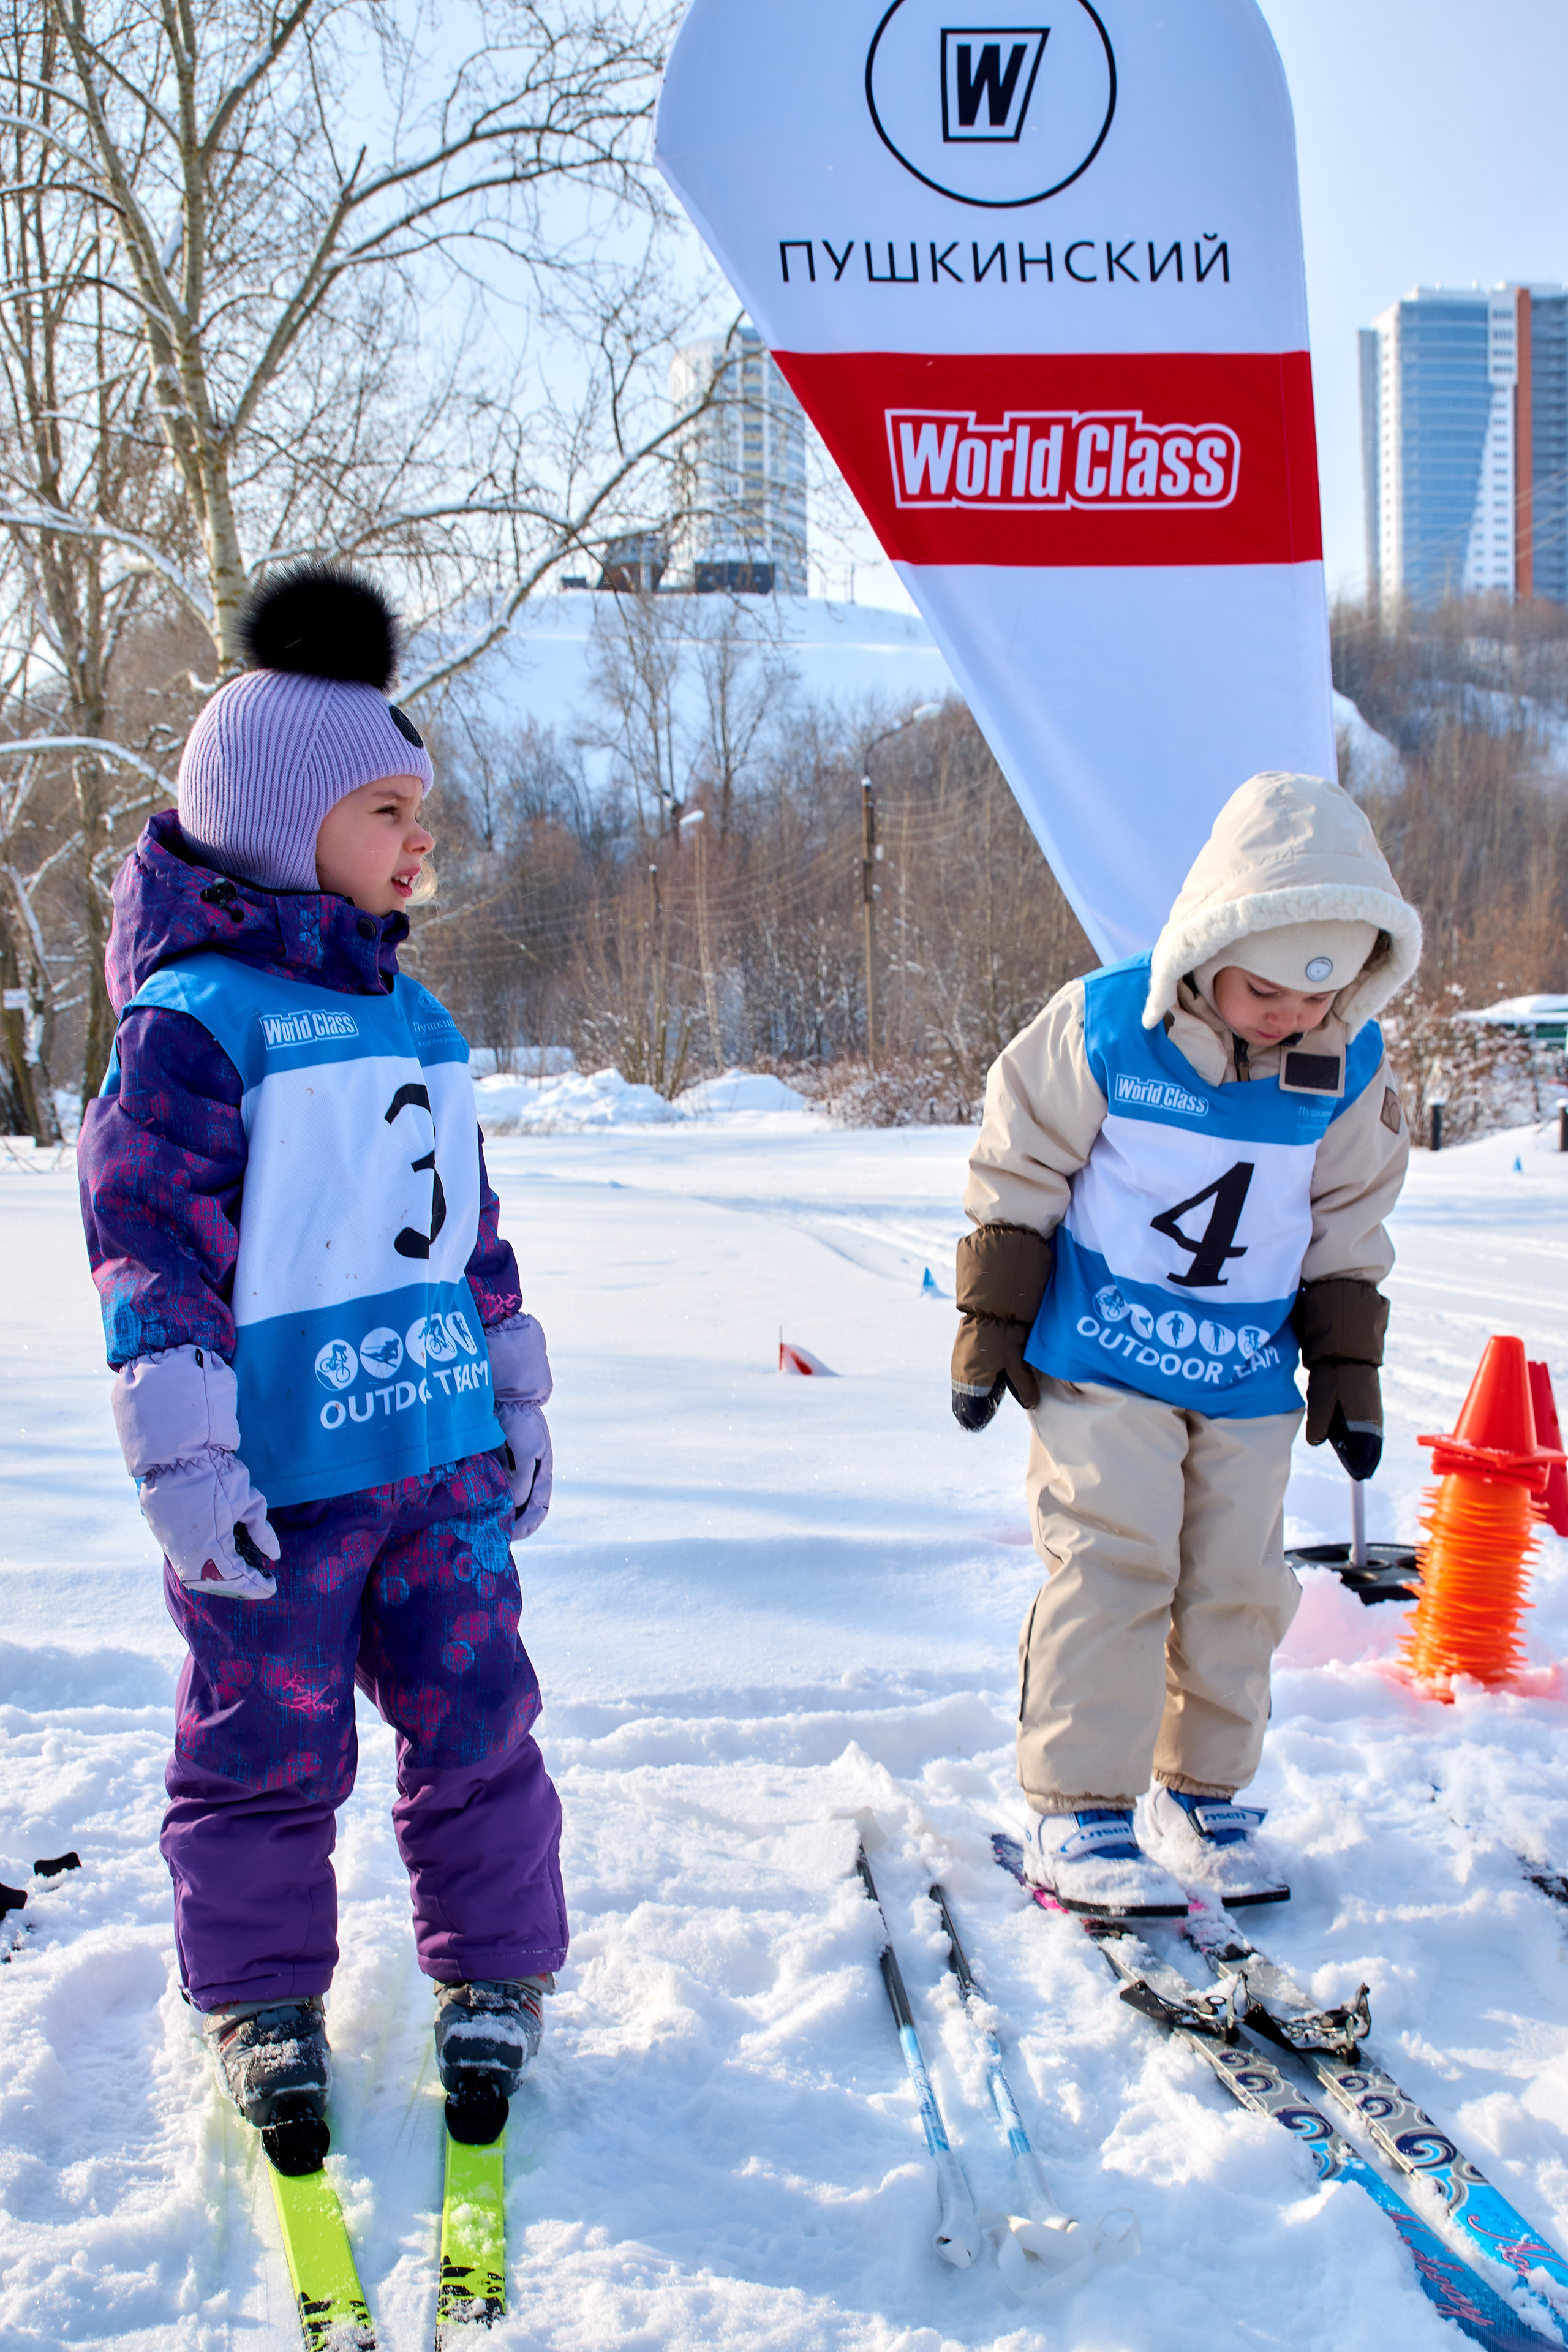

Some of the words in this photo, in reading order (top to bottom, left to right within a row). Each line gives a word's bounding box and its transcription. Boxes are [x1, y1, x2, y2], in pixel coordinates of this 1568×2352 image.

[957, 44, 1028, 126] W
[778, 232, 1231, 283] ПУШКИНСКИЙ
[899, 423, 1065, 497] World
[1075, 423, 1227, 497] Class
[263, 1014, 312, 1045] World
[312, 1012, 355, 1036] Class
[1118, 1077, 1163, 1106] World
[1164, 1085, 1205, 1114] Class
[384, 1083, 447, 1259] 3
[1150, 1161, 1255, 1286] 4
[1077, 1316, 1223, 1384] OUTDOOR
[1230, 1345, 1281, 1383] EAM
[320, 1378, 432, 1430] OUTD
